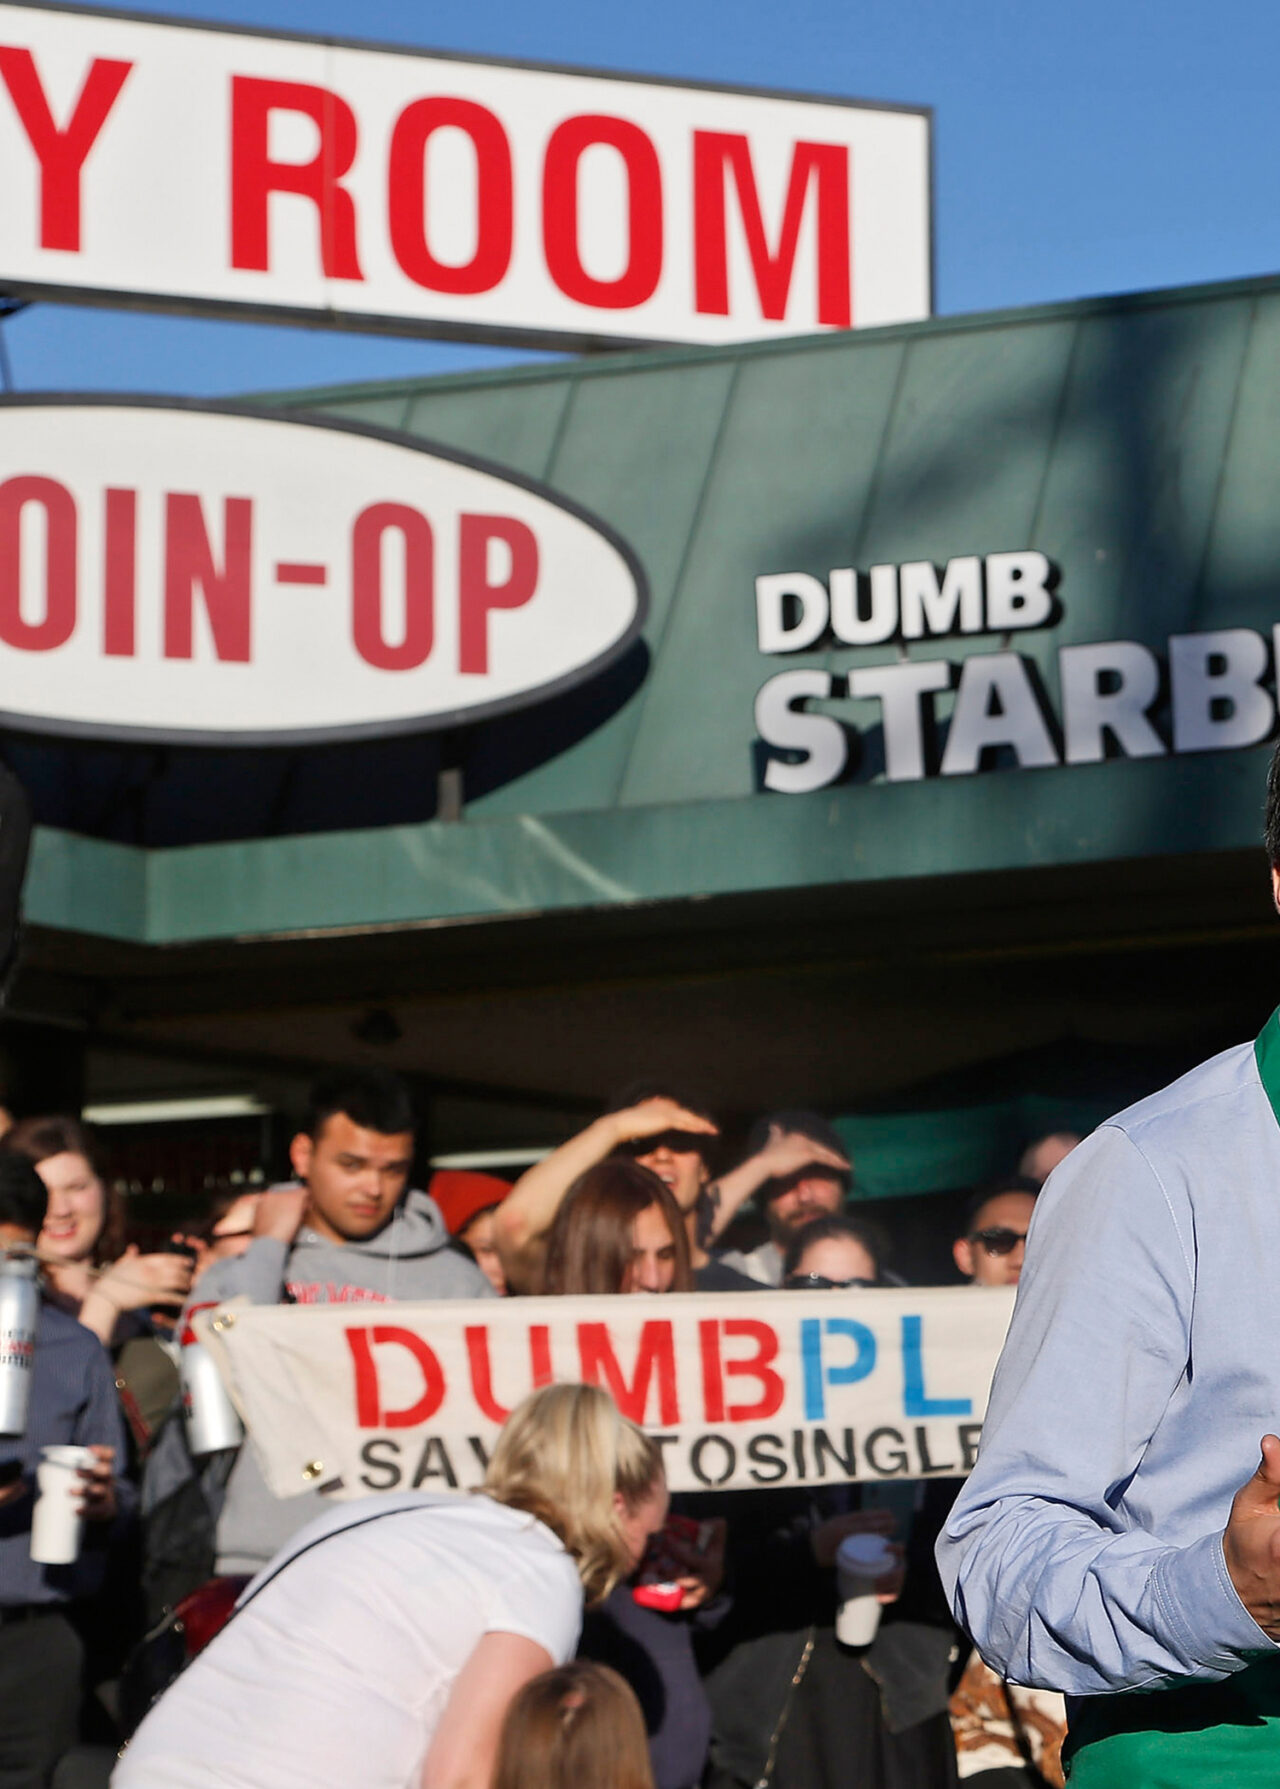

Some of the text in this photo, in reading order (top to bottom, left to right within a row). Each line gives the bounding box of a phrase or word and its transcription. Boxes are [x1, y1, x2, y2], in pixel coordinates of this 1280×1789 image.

[0, 45, 853, 329] Y ROOM
[0, 474, 541, 677] OIN-OP
[754, 549, 1052, 655] DUMB
